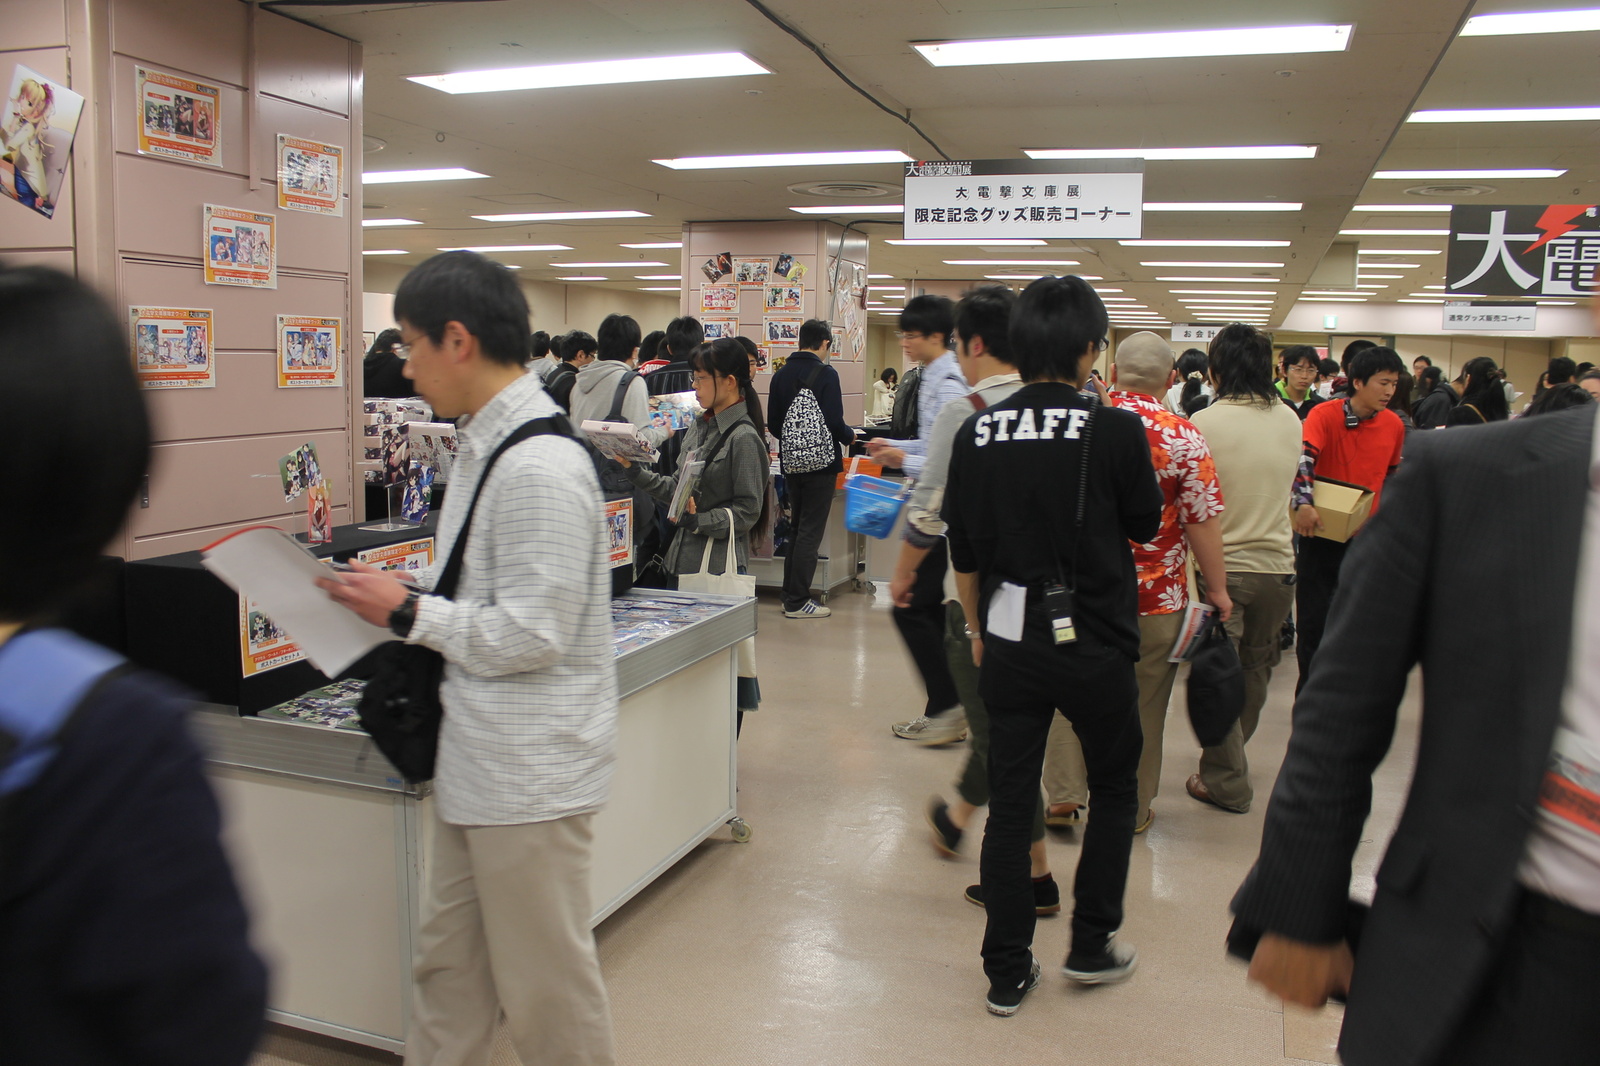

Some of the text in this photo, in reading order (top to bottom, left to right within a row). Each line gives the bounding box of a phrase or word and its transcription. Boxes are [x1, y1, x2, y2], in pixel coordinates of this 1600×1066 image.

[954, 184, 1082, 199] 大電撃文庫展
[914, 206, 1131, 223] 限定記念グッズ販売コーナー
[1448, 314, 1531, 323] 通常グッズ販売コーナー
[1183, 329, 1216, 339] お会計
[974, 408, 1090, 447] STAFF
